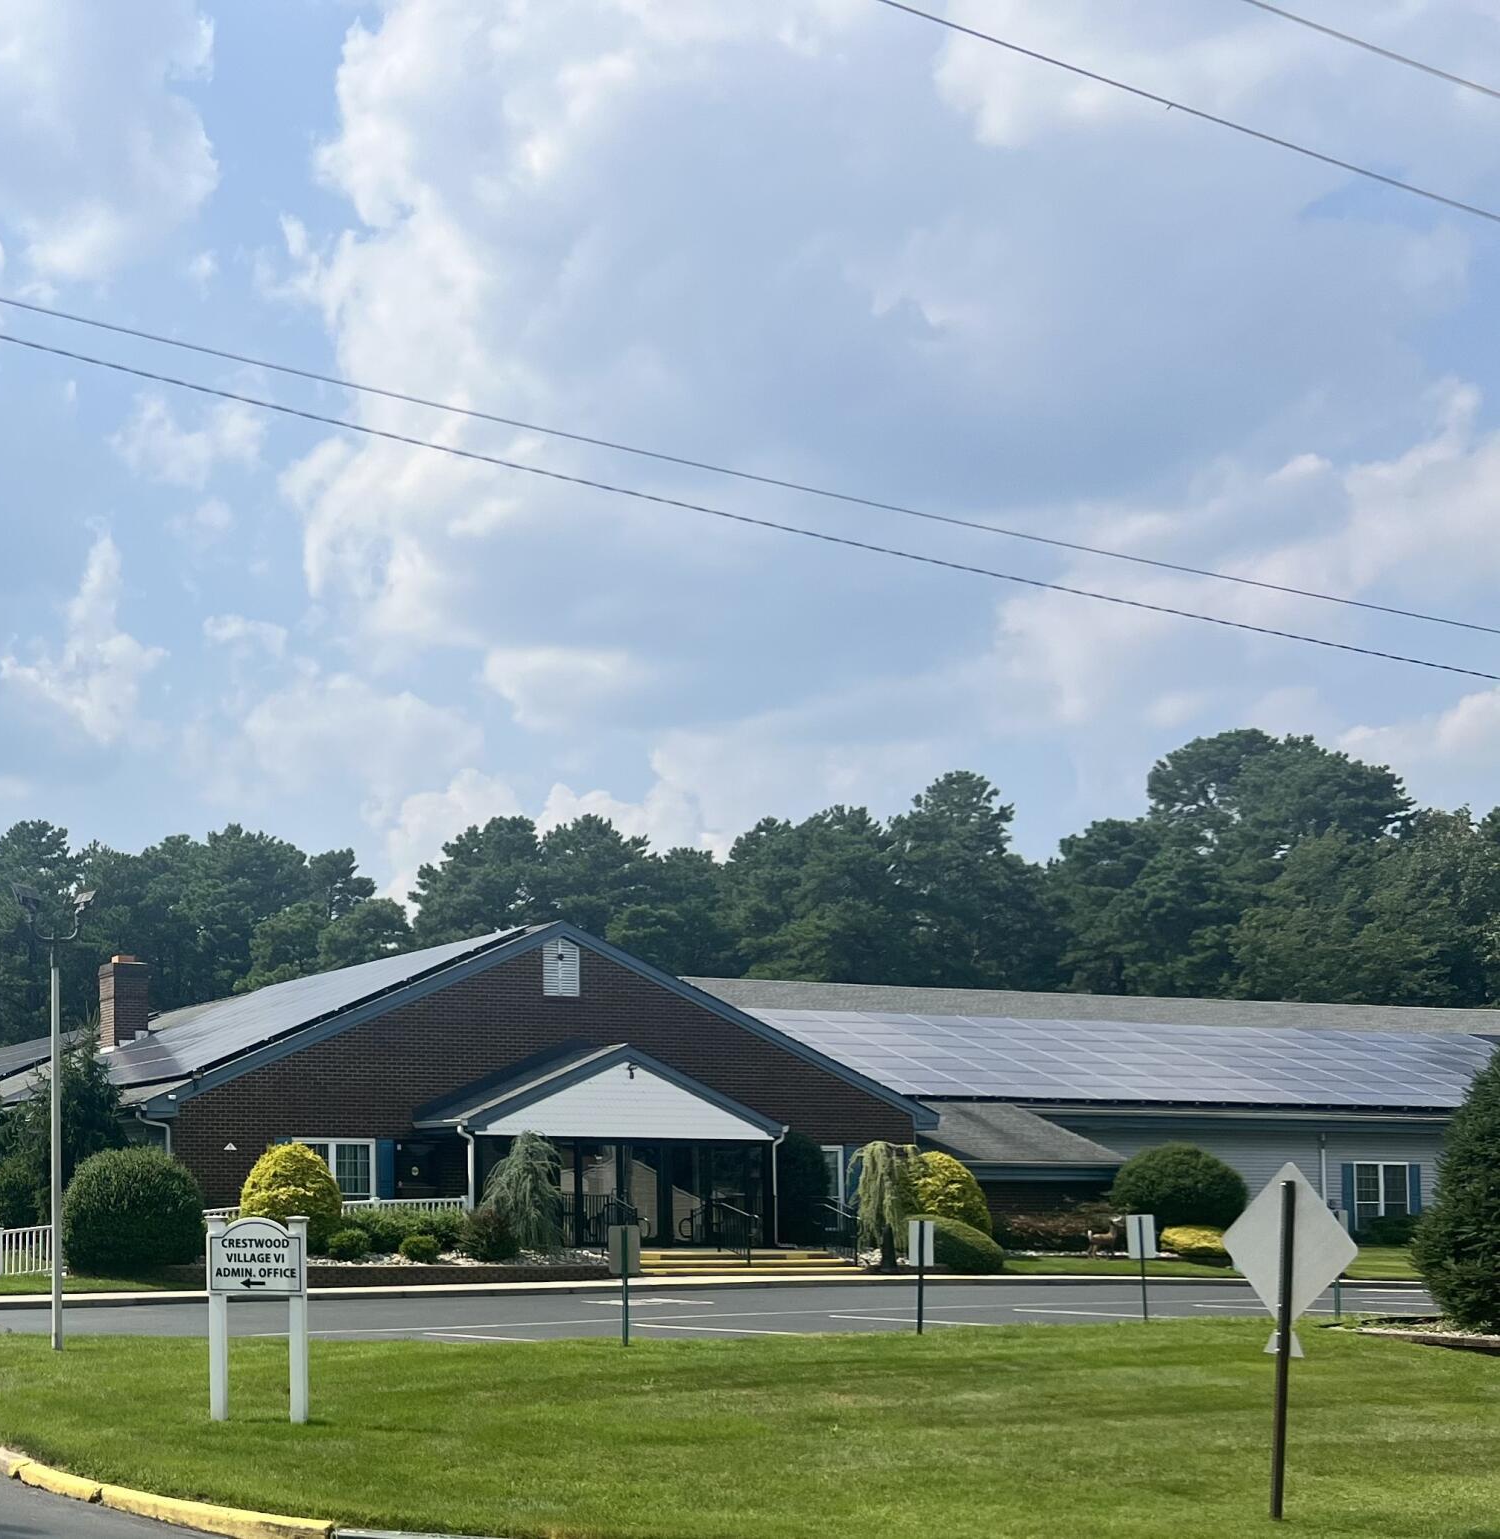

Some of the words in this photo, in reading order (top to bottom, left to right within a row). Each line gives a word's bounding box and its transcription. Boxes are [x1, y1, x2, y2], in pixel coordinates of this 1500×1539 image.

[221, 1238, 290, 1249] CRESTWOOD
[226, 1253, 271, 1263] VILLAGE
[273, 1253, 285, 1263] VI
[215, 1267, 256, 1278] ADMIN.
[258, 1267, 297, 1278] OFFICE
